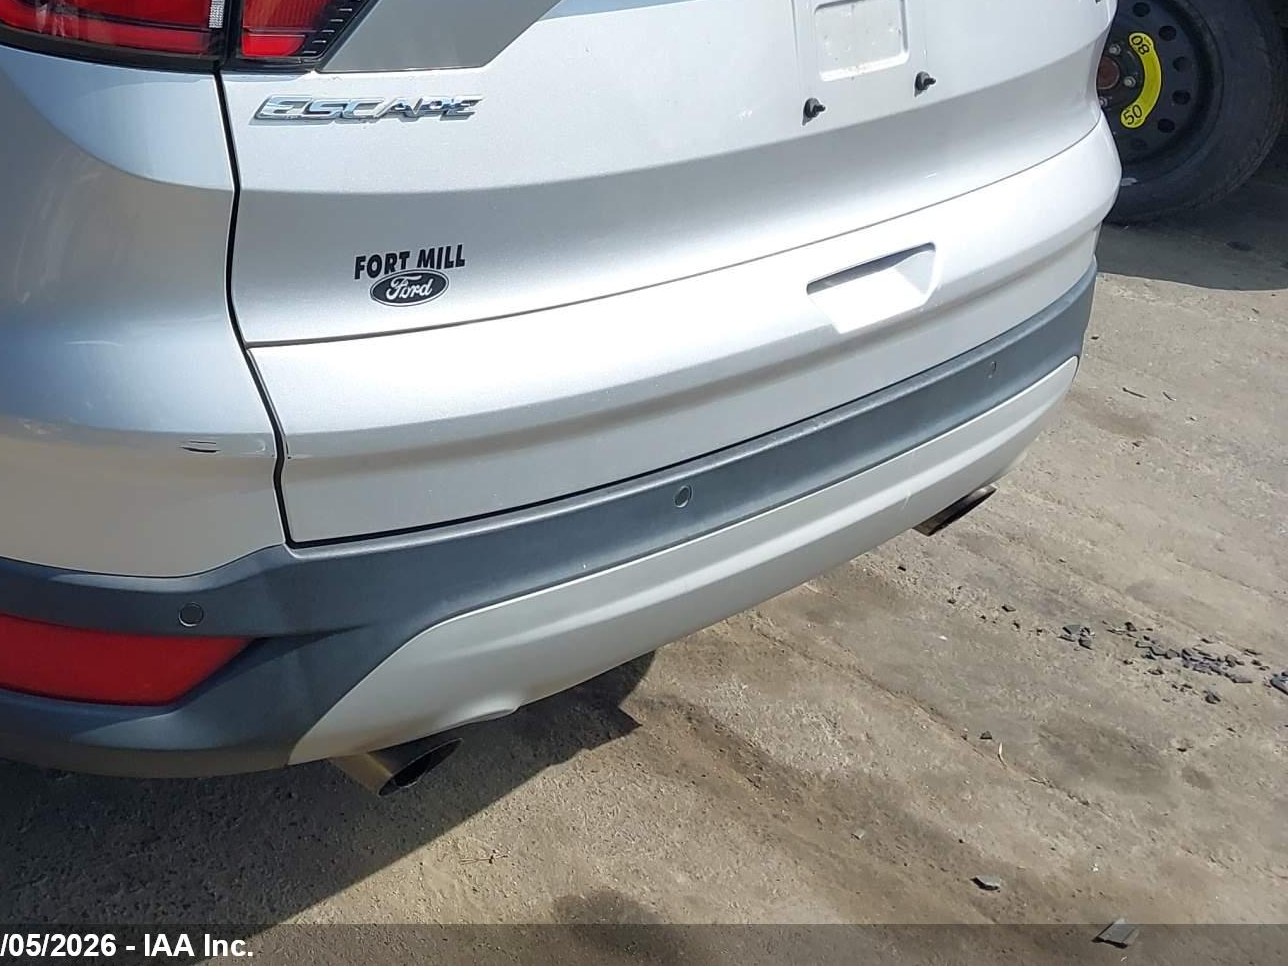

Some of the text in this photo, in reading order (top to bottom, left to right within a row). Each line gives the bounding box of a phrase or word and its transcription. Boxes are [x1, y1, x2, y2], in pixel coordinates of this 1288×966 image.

[254, 94, 484, 122] ESCAPE
[1123, 104, 1143, 125] 50
[354, 244, 466, 280] FORT MILL
[385, 274, 434, 301] Ford
